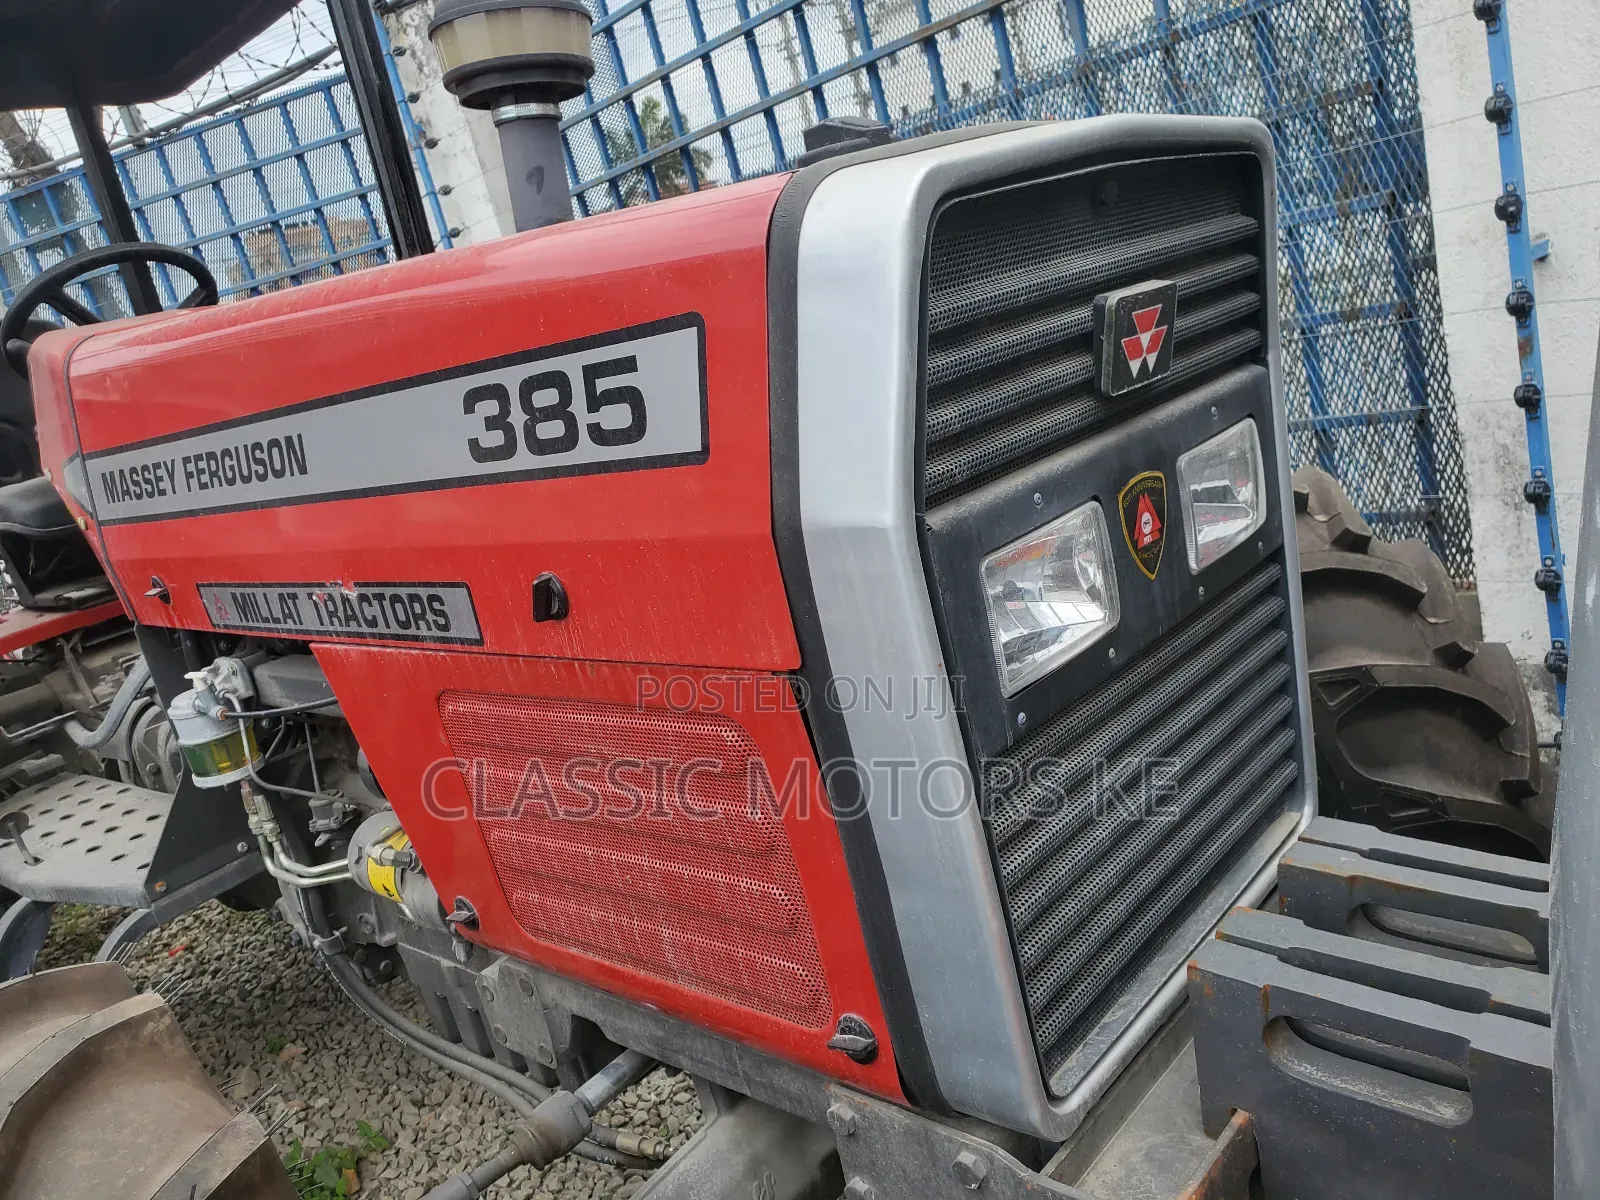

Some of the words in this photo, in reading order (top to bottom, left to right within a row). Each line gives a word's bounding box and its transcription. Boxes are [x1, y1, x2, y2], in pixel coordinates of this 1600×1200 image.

[463, 354, 647, 463] 385
[101, 458, 176, 504] MASSEY
[182, 433, 308, 492] FERGUSON
[230, 591, 304, 626] MILLAT
[306, 591, 452, 632] TRACTORS
